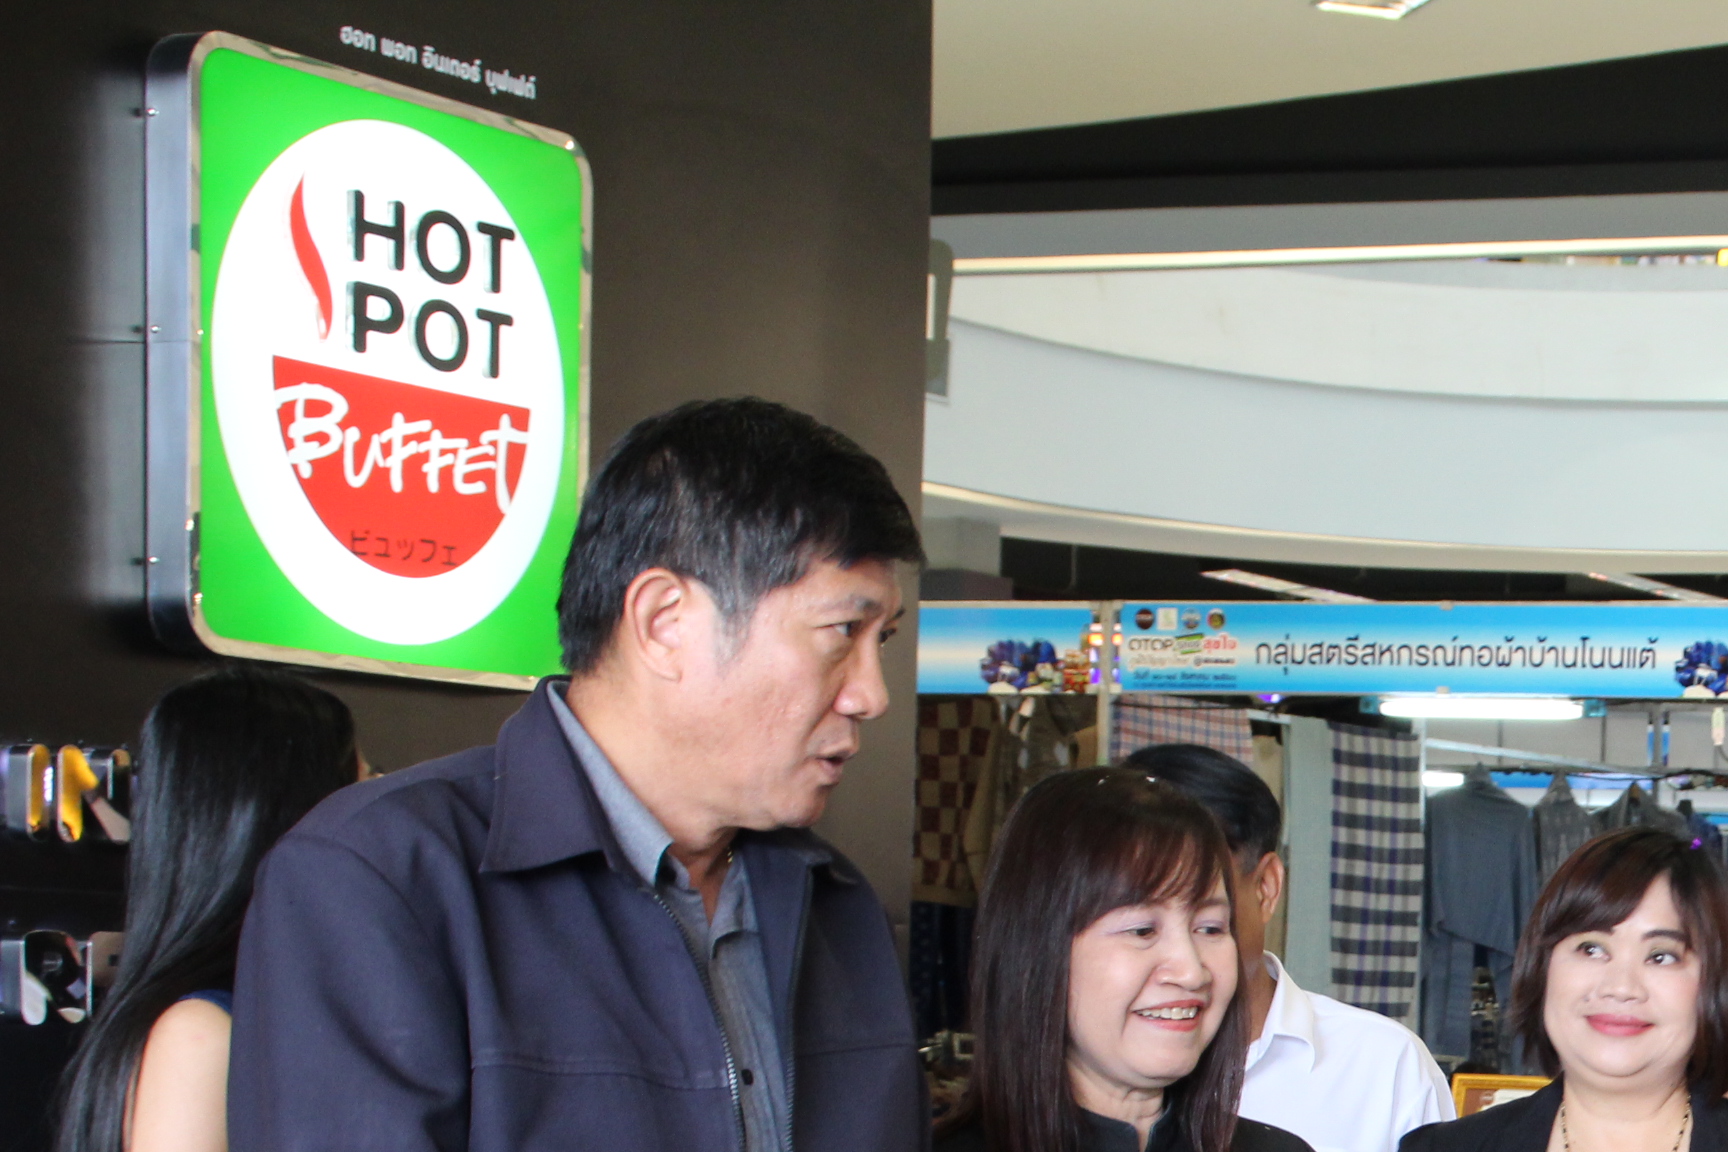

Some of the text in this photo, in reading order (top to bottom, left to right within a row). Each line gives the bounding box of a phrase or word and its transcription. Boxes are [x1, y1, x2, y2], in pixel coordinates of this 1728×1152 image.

[349, 190, 515, 294] HOT
[350, 281, 514, 379] POT
[276, 383, 530, 515] BUFFET
[1254, 633, 1659, 677] กลุ่มสตรีสหกรณ์ทอผ้าบ้านโนนแต้
